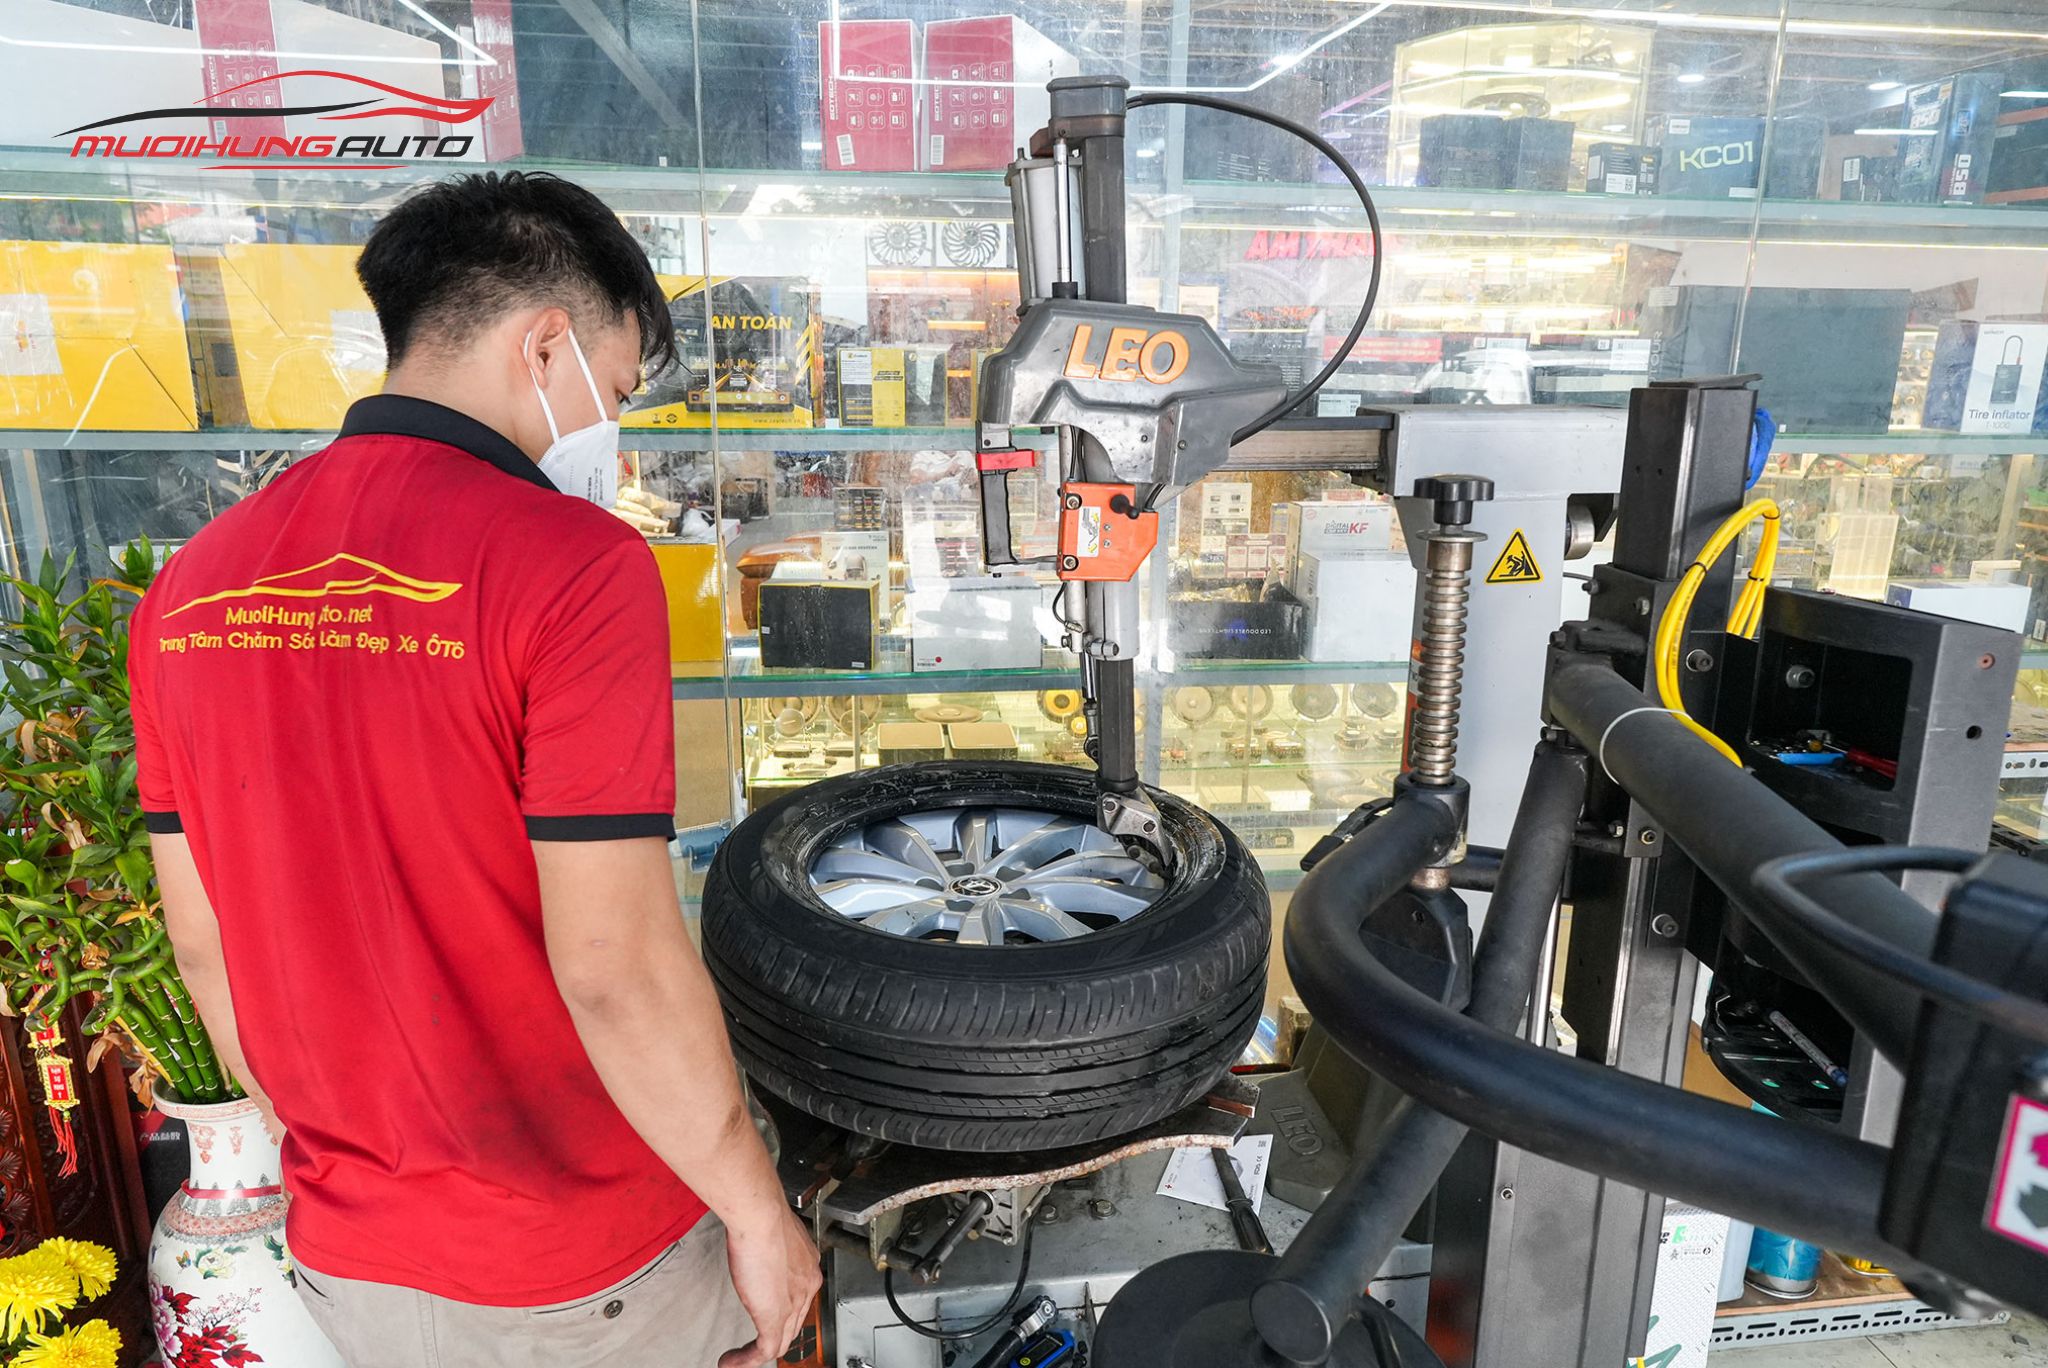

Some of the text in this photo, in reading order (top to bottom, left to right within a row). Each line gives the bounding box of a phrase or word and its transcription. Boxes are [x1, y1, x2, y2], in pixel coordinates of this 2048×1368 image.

[1064, 324, 1191, 385] LEO
[1969, 408, 2032, 420] Tire inflator
[1349, 522, 1369, 534] KF
[188, 631, 223, 649] Tâm
[227, 631, 283, 649] Chăm
[355, 632, 390, 654] Đẹp
[396, 634, 420, 653] Xe
[1270, 1104, 1325, 1156] LEO
